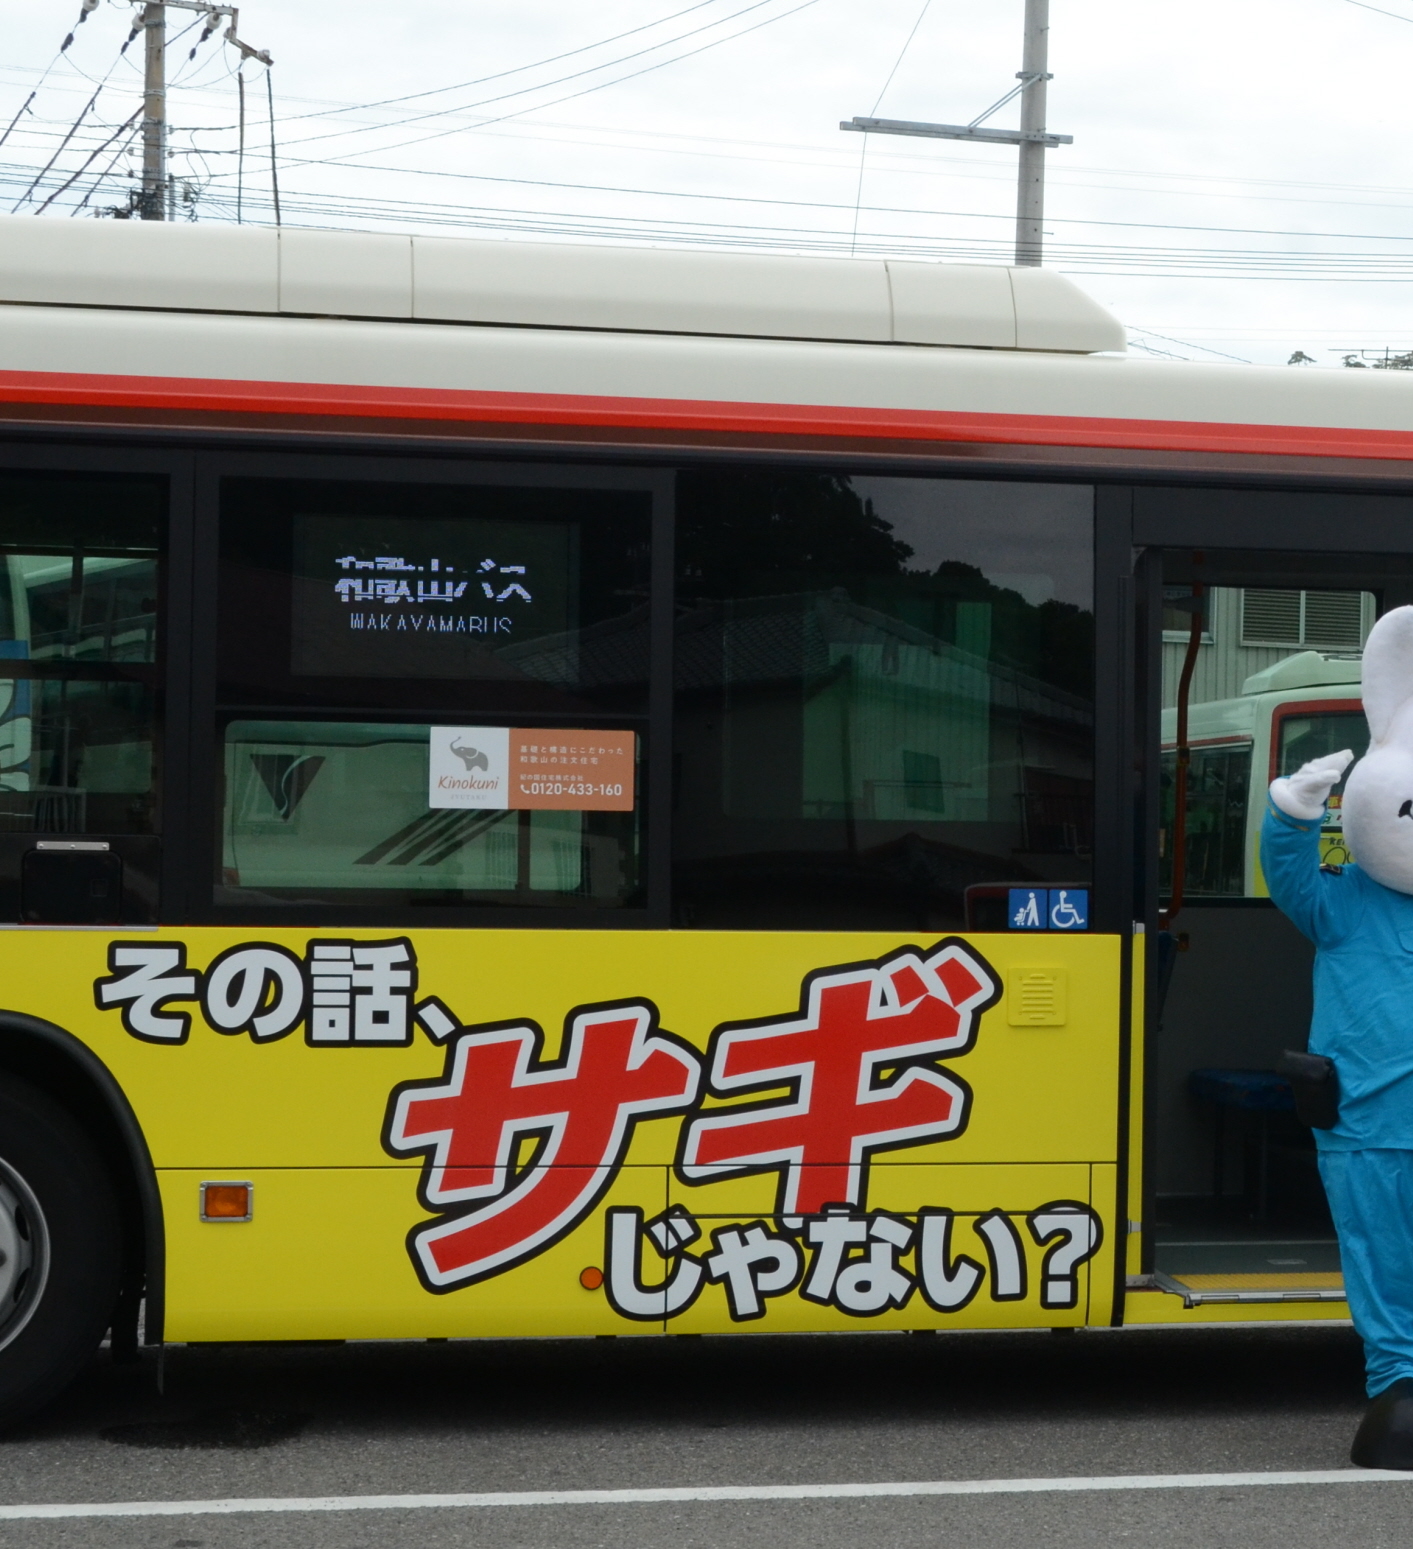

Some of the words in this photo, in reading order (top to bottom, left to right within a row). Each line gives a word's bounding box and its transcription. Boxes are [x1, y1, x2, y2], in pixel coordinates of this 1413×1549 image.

[520, 756, 599, 765] 和歌山の注文住宅
[438, 775, 499, 790] Kinokuni
[531, 783, 622, 796] 0120-433-160
[381, 936, 1004, 1294] サギ
[605, 1199, 1101, 1321] じゃない?
